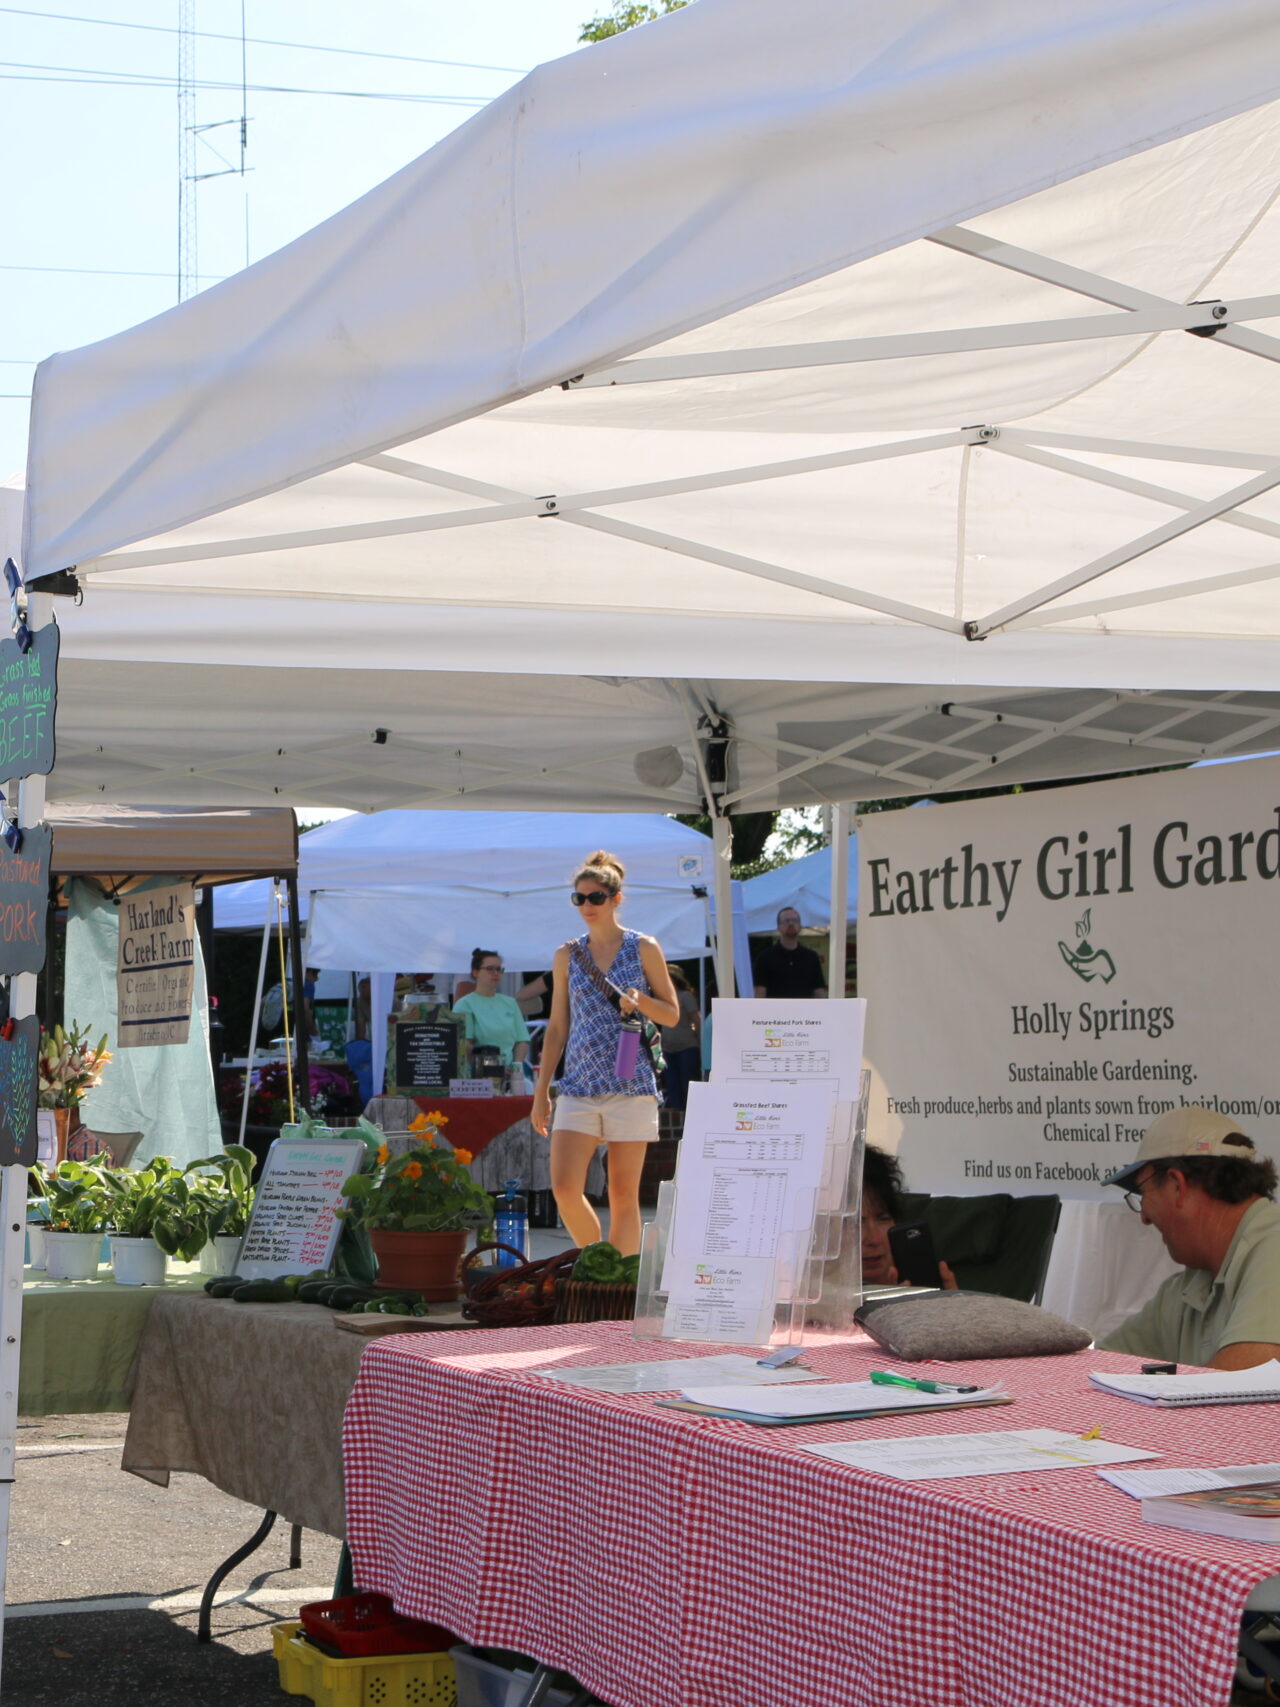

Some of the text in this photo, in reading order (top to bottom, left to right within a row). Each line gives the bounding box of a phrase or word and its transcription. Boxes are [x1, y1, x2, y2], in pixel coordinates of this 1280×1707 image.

[867, 843, 1022, 923] Earthy
[1037, 823, 1135, 901] Girl
[127, 896, 185, 932] Harland's
[122, 931, 194, 965] Creek Farm
[1011, 999, 1174, 1041] Holly Springs
[1008, 1059, 1198, 1085] Sustainable Gardening.
[887, 1096, 920, 1114] Fresh
[1016, 1096, 1042, 1114] and
[1045, 1095, 1091, 1118] plants
[1095, 1100, 1134, 1114] sown
[1137, 1095, 1175, 1114] from
[1043, 1123, 1110, 1142] Chemical
[964, 1160, 993, 1178] Find
[997, 1165, 1011, 1178] us
[1015, 1165, 1032, 1179] on
[1035, 1161, 1101, 1181] Facebook
